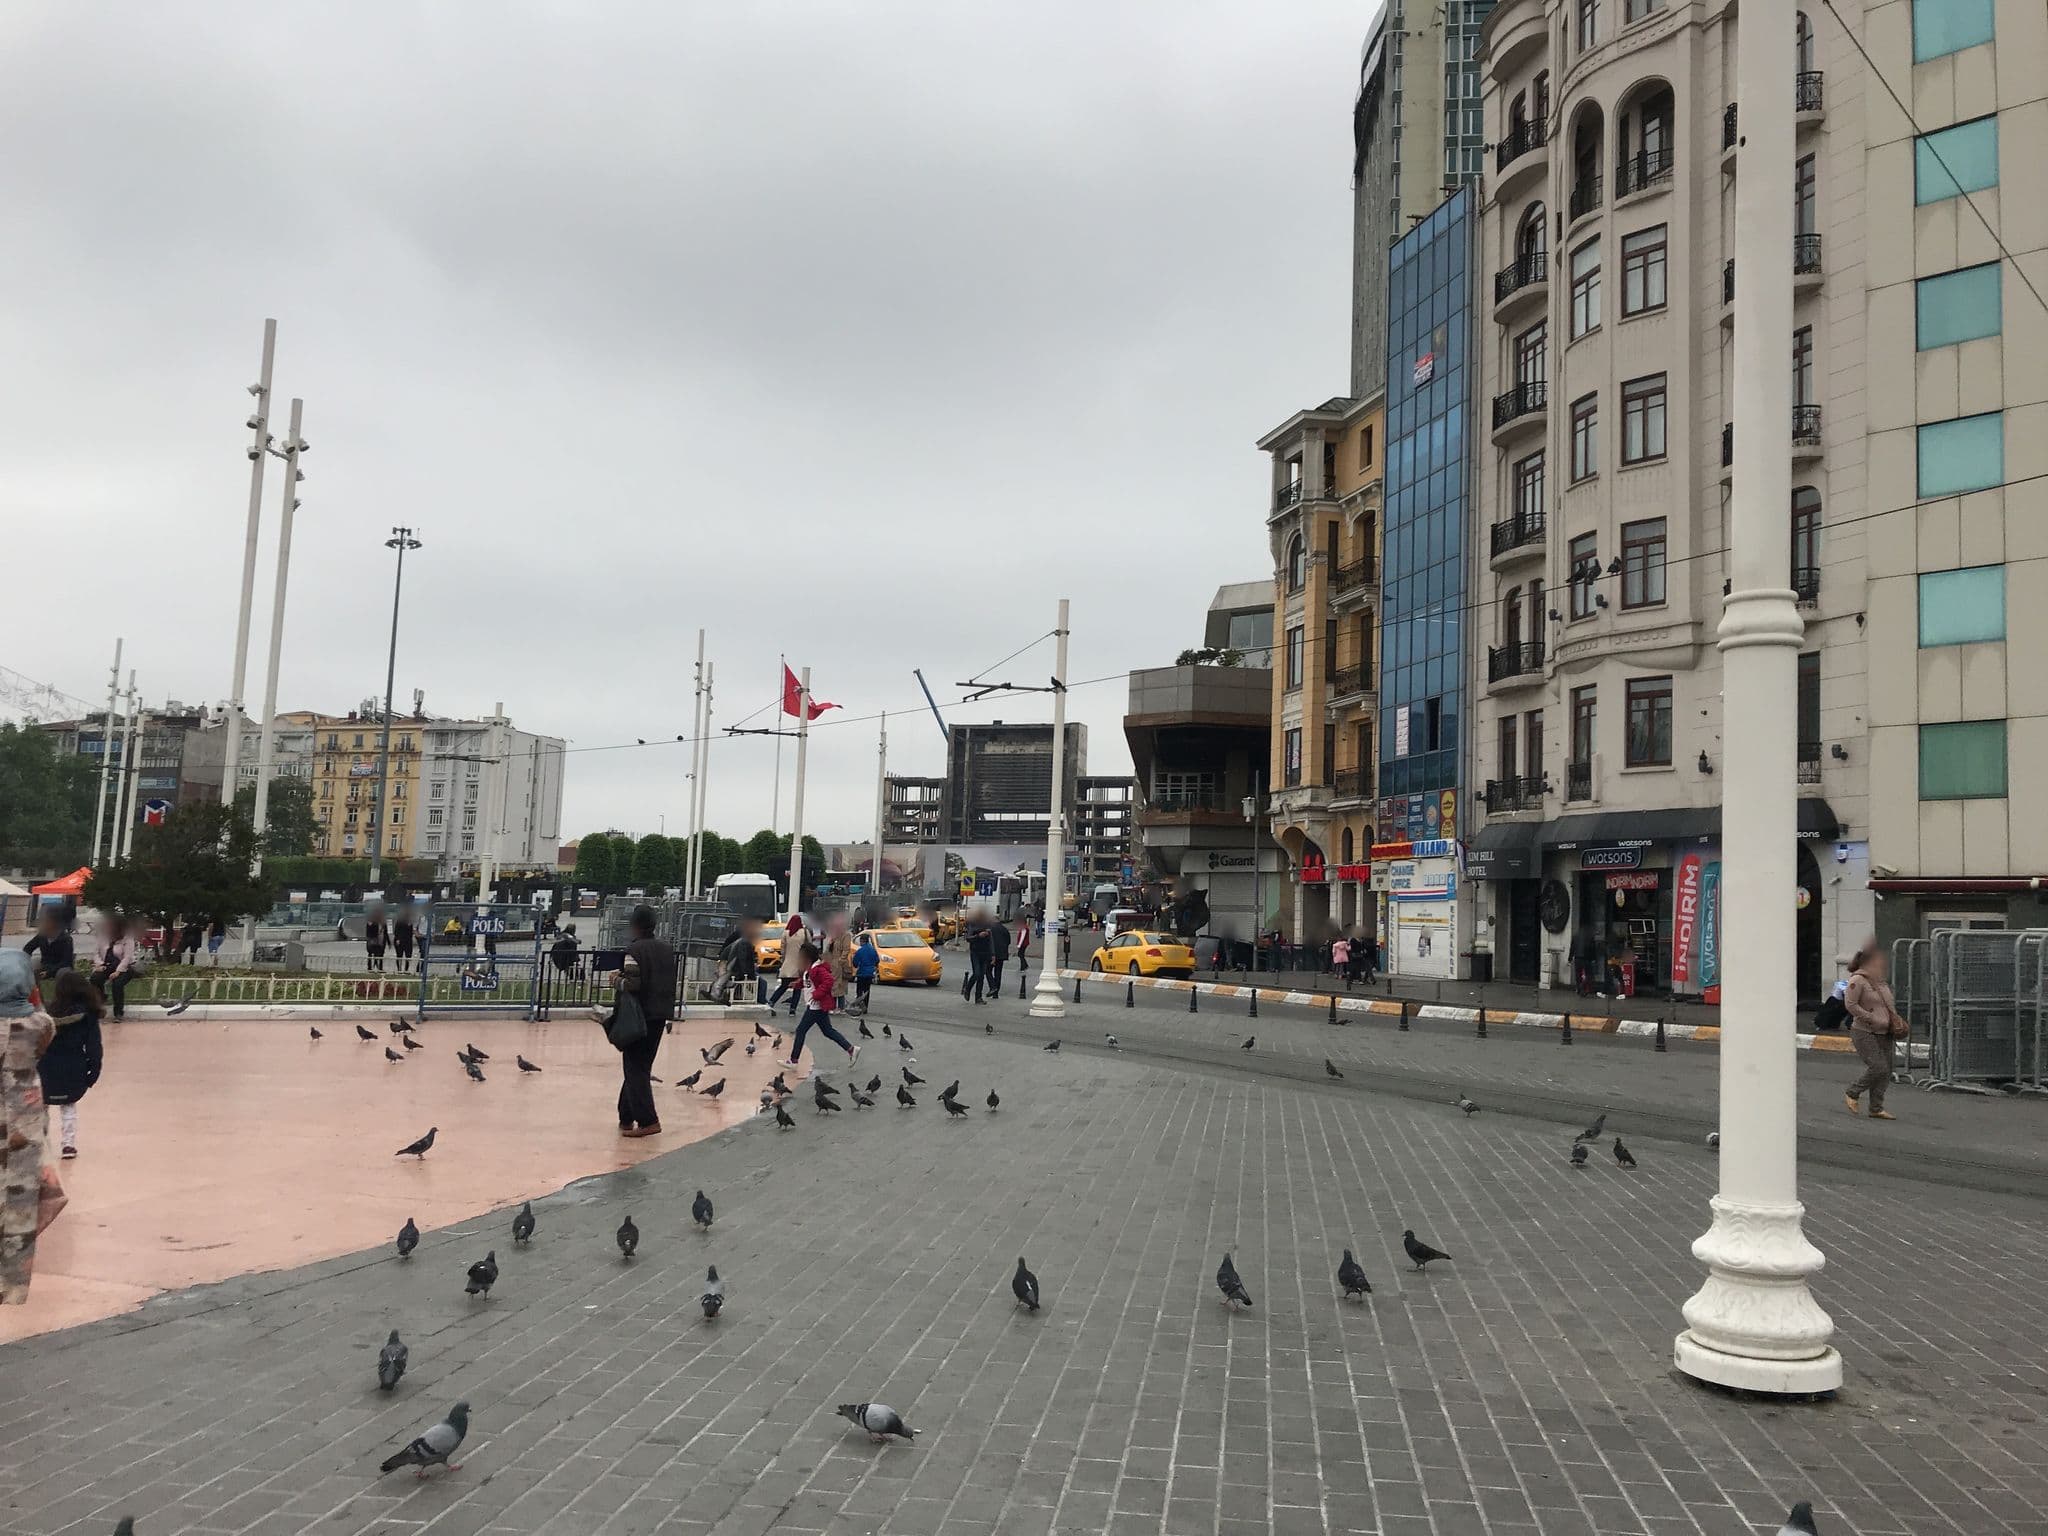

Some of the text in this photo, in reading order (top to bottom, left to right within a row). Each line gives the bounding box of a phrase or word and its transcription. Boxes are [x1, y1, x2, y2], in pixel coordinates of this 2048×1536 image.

[1618, 839, 1652, 847] watsons
[1220, 855, 1255, 867] Garant
[1480, 850, 1495, 861] HILL
[1588, 851, 1633, 864] watsons
[1467, 865, 1487, 876] HOTEL
[472, 917, 504, 933] POLİS
